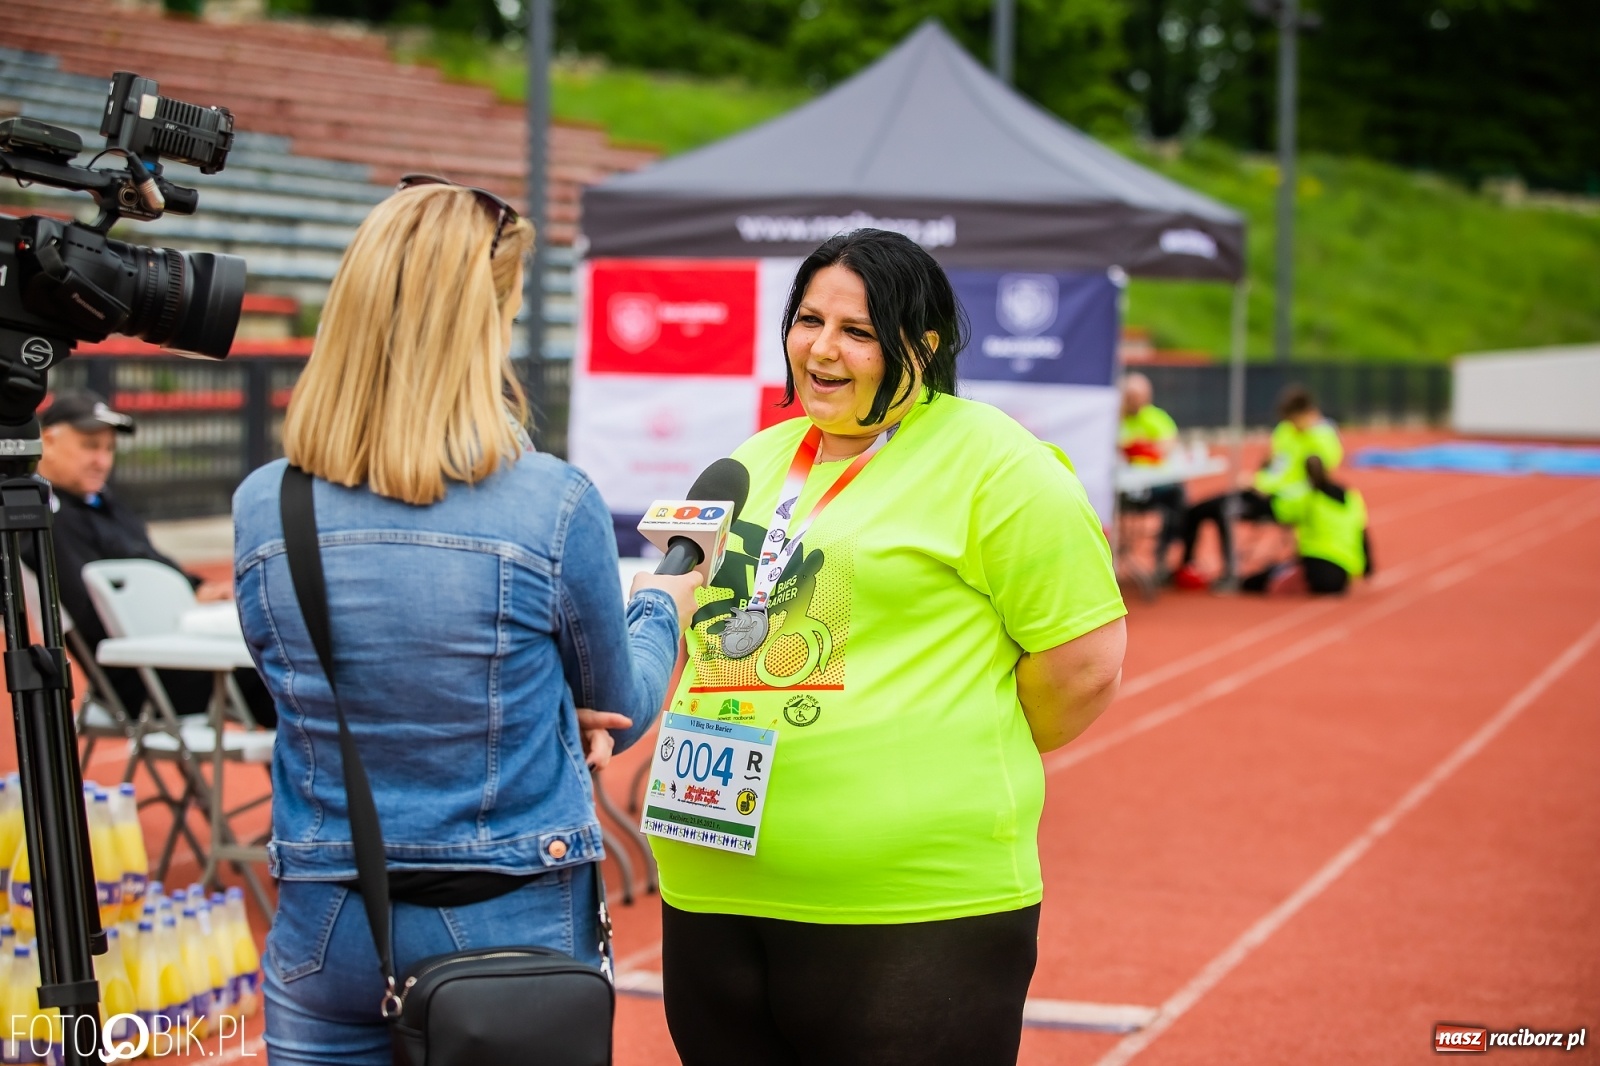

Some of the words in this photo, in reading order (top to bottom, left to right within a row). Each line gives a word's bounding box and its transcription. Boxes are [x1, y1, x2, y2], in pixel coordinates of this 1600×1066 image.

[705, 722, 715, 730] Bez
[715, 723, 733, 733] Barier
[676, 739, 734, 787] 004
[746, 750, 763, 773] R
